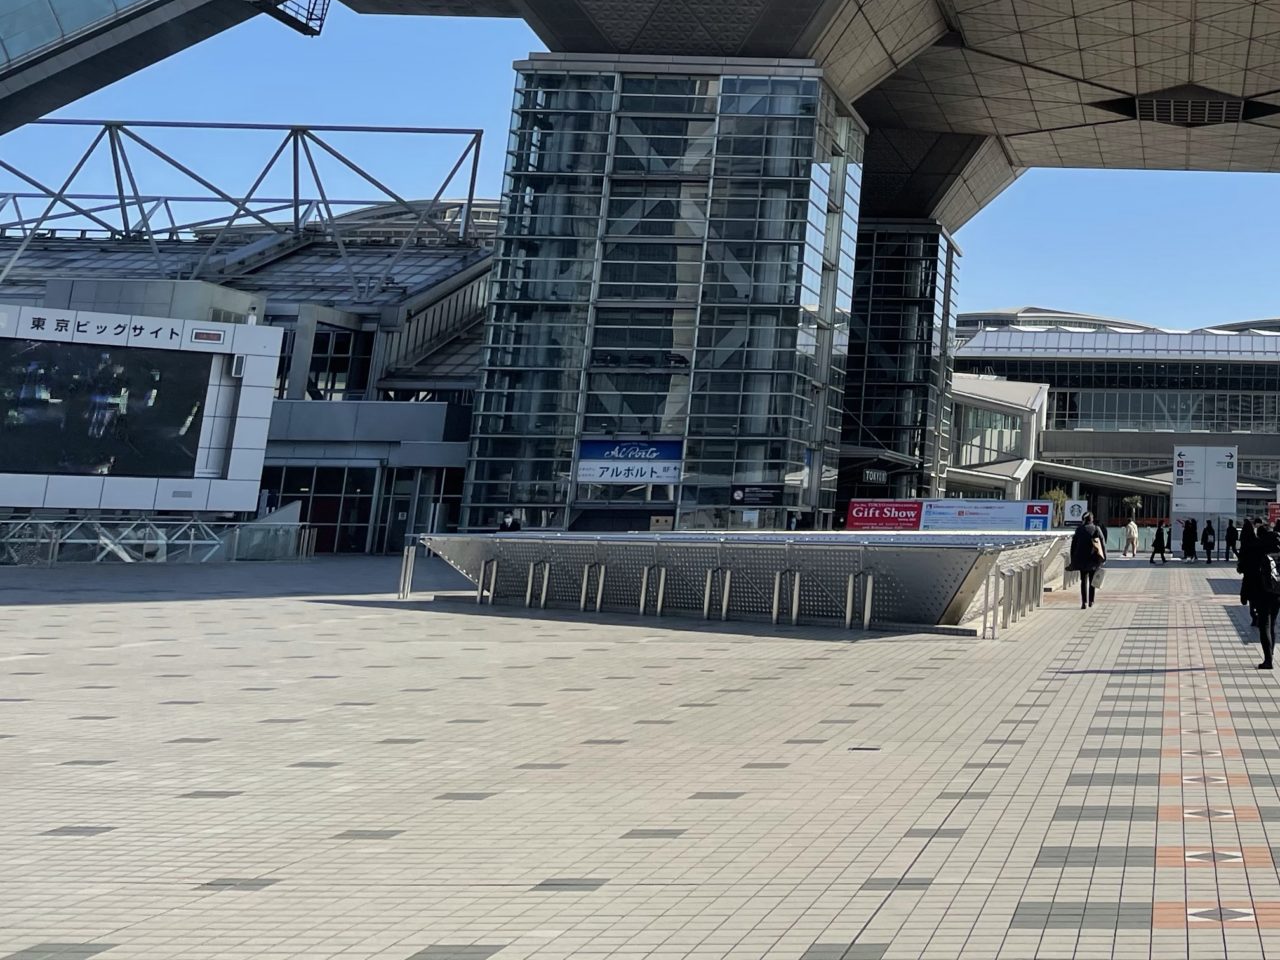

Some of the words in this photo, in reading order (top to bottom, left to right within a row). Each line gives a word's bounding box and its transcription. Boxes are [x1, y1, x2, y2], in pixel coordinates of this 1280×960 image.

[30, 316, 180, 340] 東京ビッグサイト
[852, 507, 880, 518] Gift
[882, 507, 917, 518] Show
